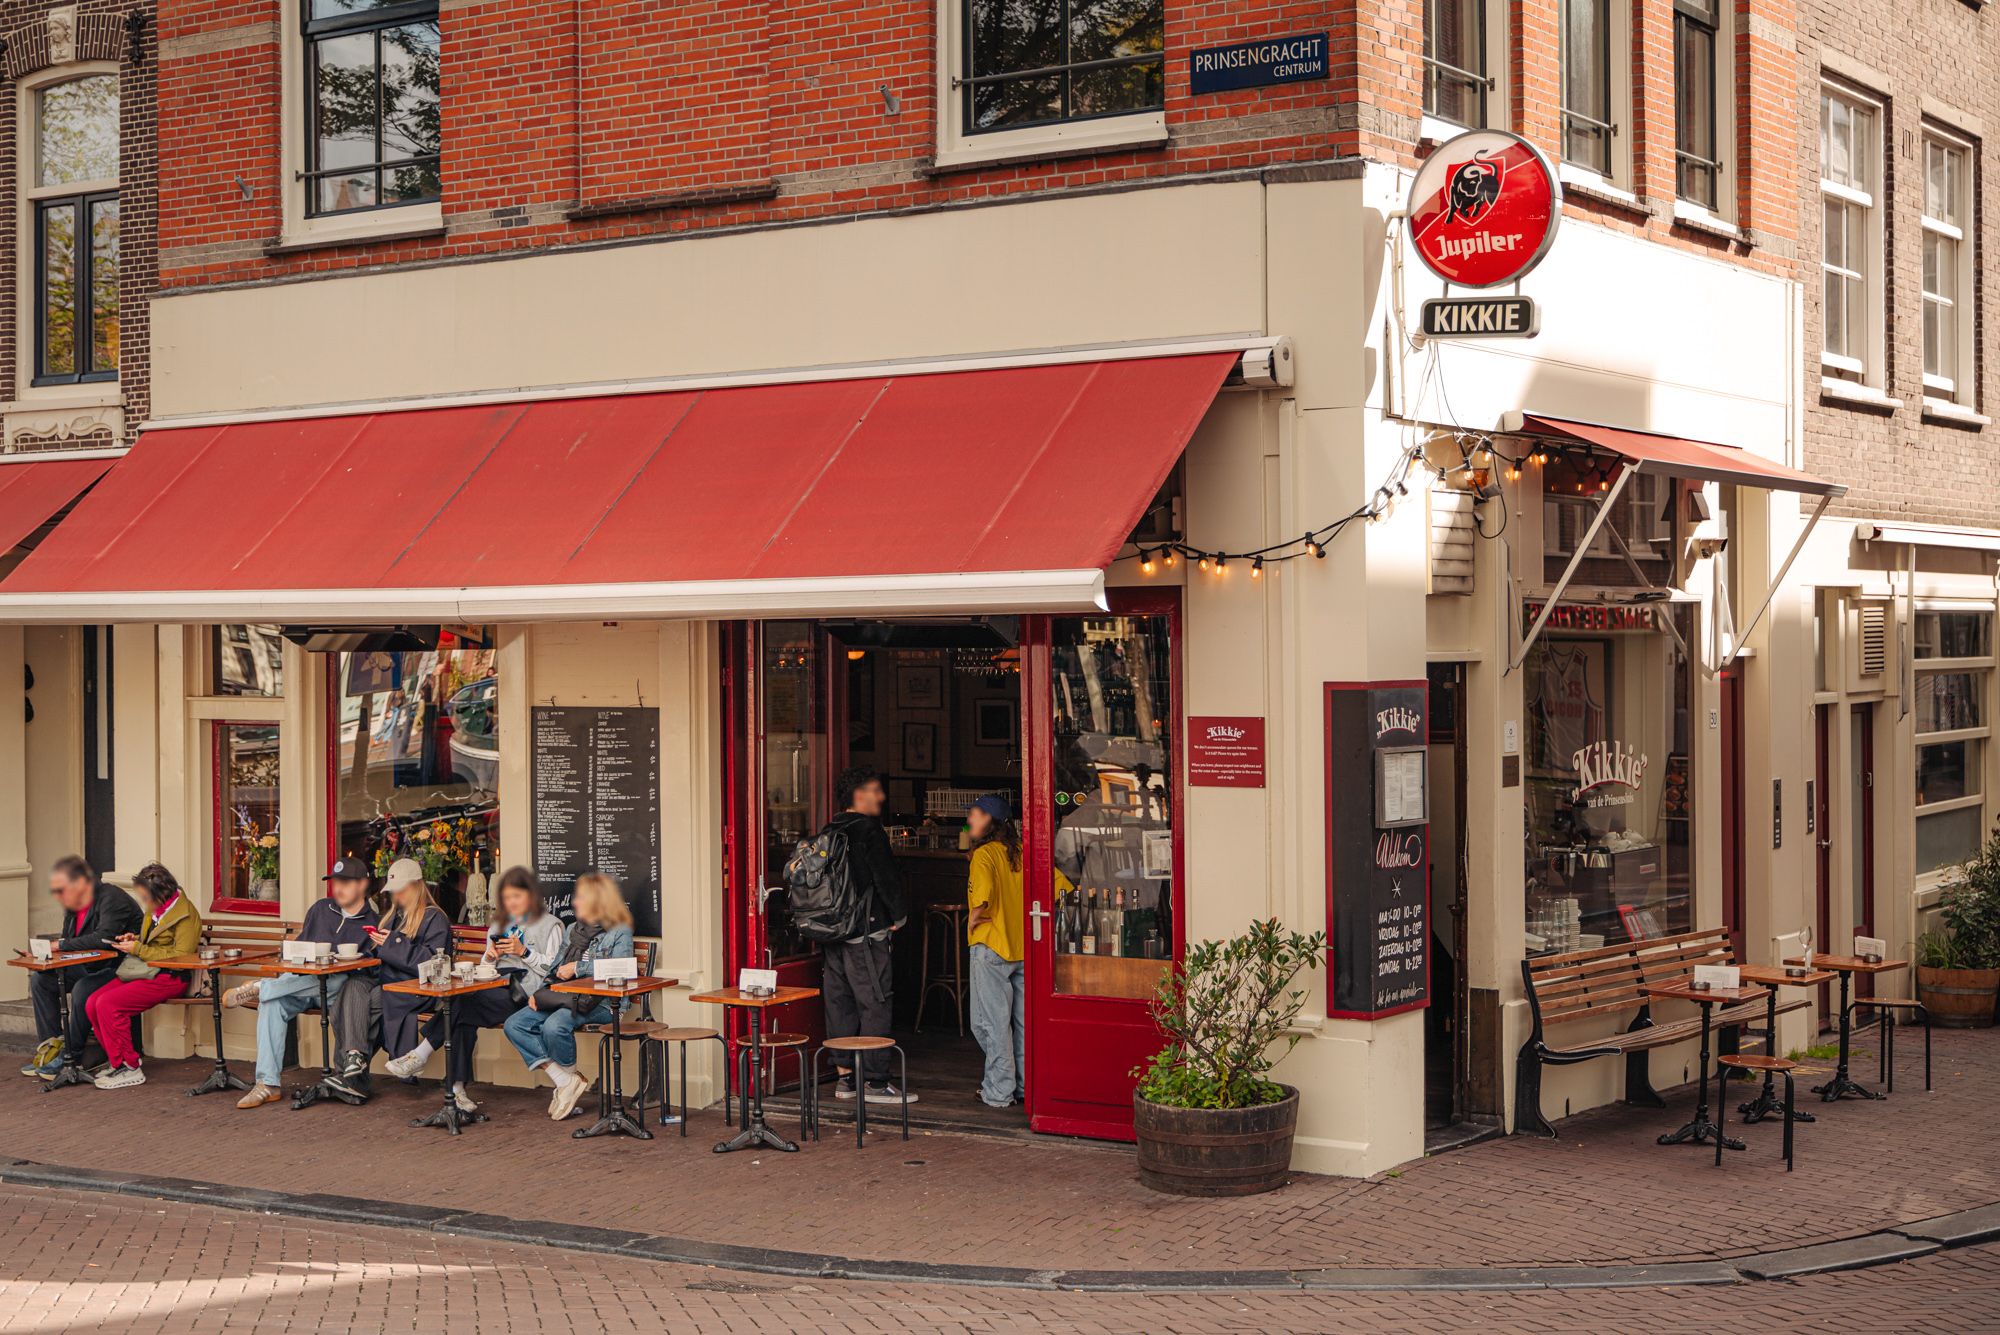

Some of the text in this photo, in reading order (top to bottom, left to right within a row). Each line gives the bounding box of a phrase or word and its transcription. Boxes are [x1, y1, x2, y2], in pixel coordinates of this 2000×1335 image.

[1195, 38, 1321, 73] PRINSENGRACHT
[1273, 61, 1322, 78] CENTRUM
[1435, 230, 1523, 261] Jupiler
[1433, 303, 1520, 333] KIKKIE
